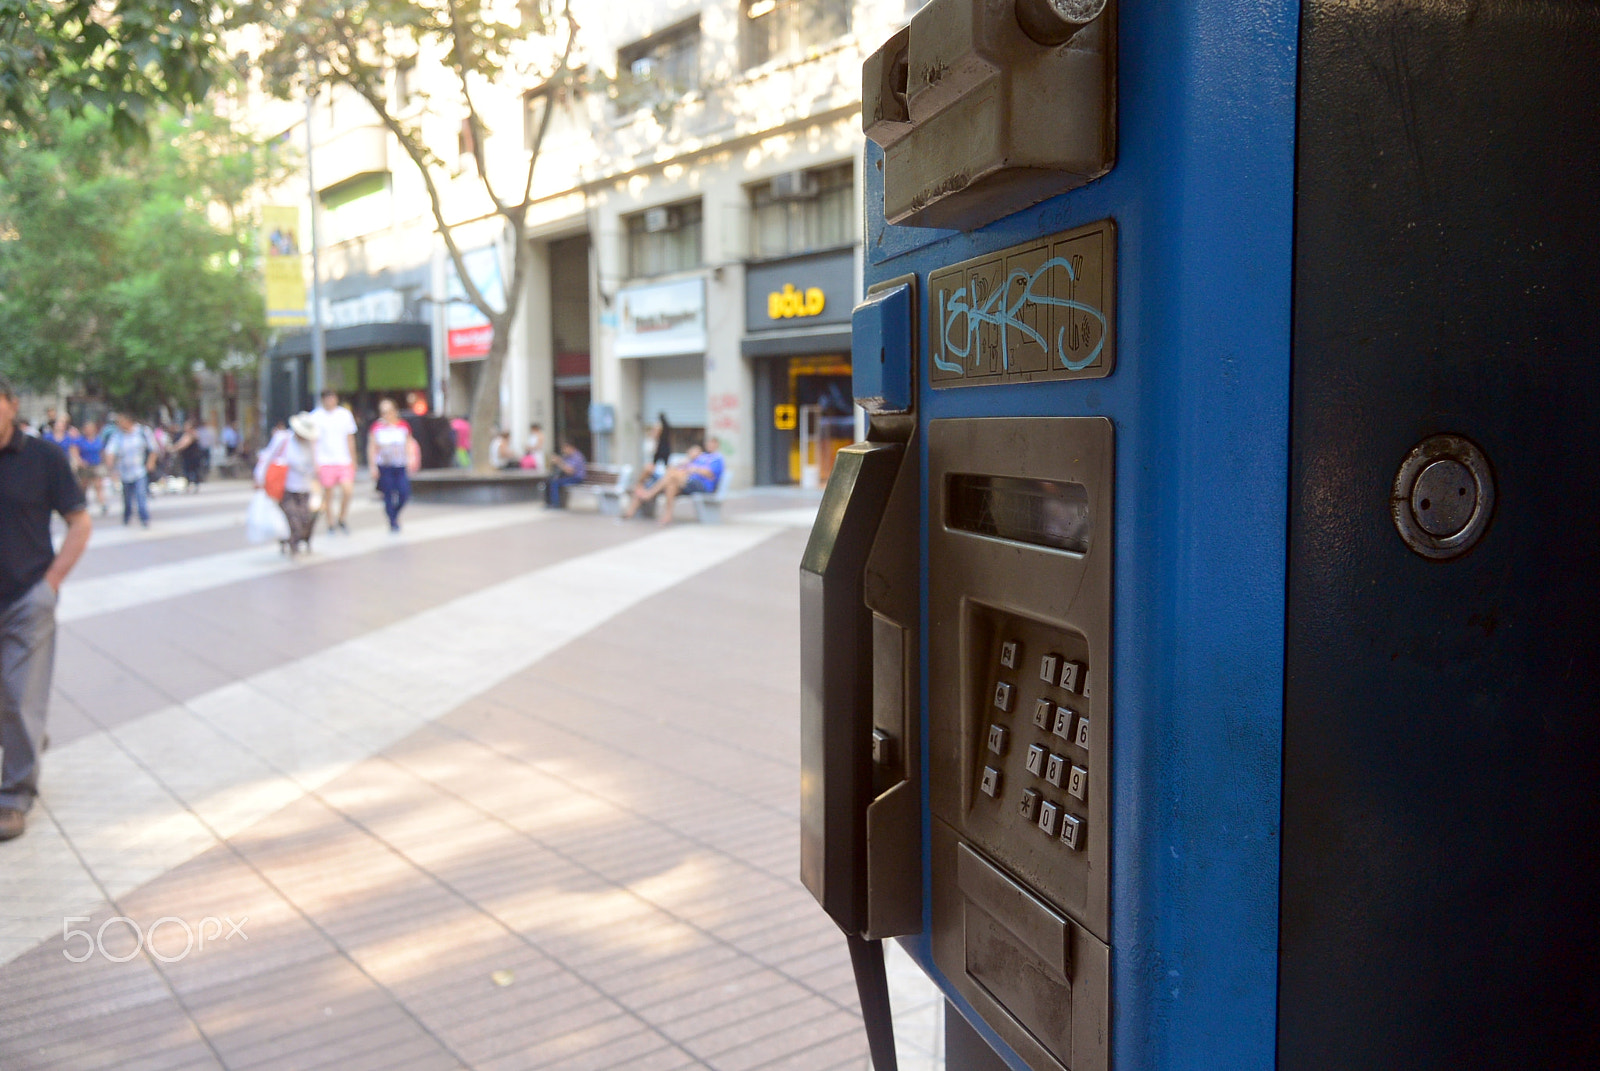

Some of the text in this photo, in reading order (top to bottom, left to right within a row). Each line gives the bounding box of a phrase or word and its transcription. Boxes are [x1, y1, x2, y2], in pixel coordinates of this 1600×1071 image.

[1043, 660, 1049, 677] 1
[1064, 667, 1071, 685] 2
[1035, 706, 1087, 743] 4 5 6
[1030, 751, 1079, 792] 7 8 9
[1042, 809, 1049, 827] 0
